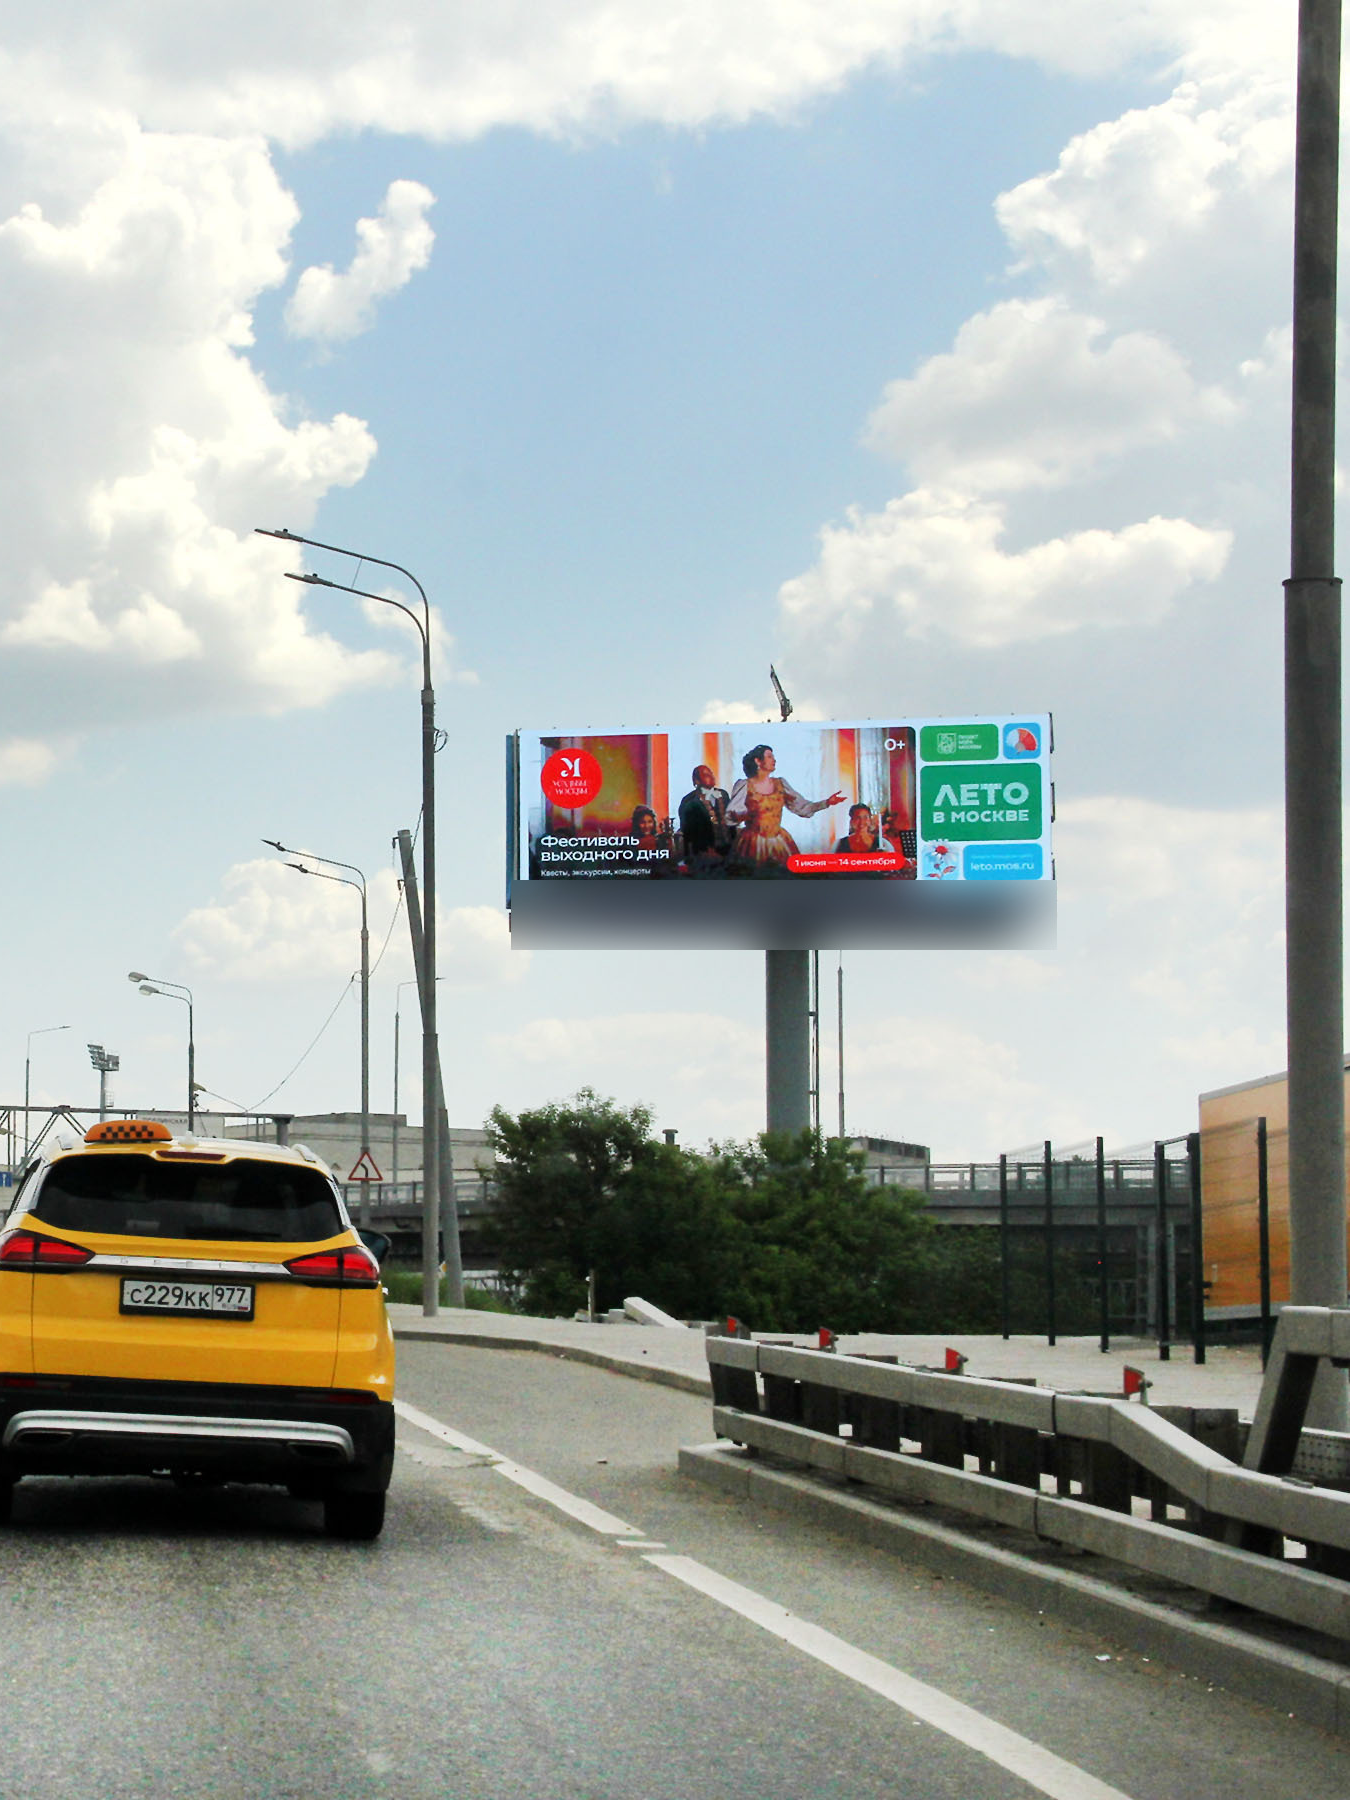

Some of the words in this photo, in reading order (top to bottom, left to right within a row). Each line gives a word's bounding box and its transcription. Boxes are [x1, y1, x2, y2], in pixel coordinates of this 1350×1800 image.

[884, 738, 905, 751] 0+
[933, 782, 1029, 807] ЛЕТО
[933, 812, 945, 823] В
[951, 810, 1029, 823] МОСКВЕ
[540, 834, 640, 848] Фестиваль
[541, 850, 634, 863] выходного
[637, 849, 670, 861] дня
[850, 857, 896, 866] сентября
[540, 869, 570, 877] Квесты,
[571, 868, 613, 877] экскурсии,
[614, 867, 651, 876] концерты
[970, 862, 1035, 871] leto.mos.ru
[130, 1285, 210, 1307] С229КК
[214, 1287, 246, 1304] 977
